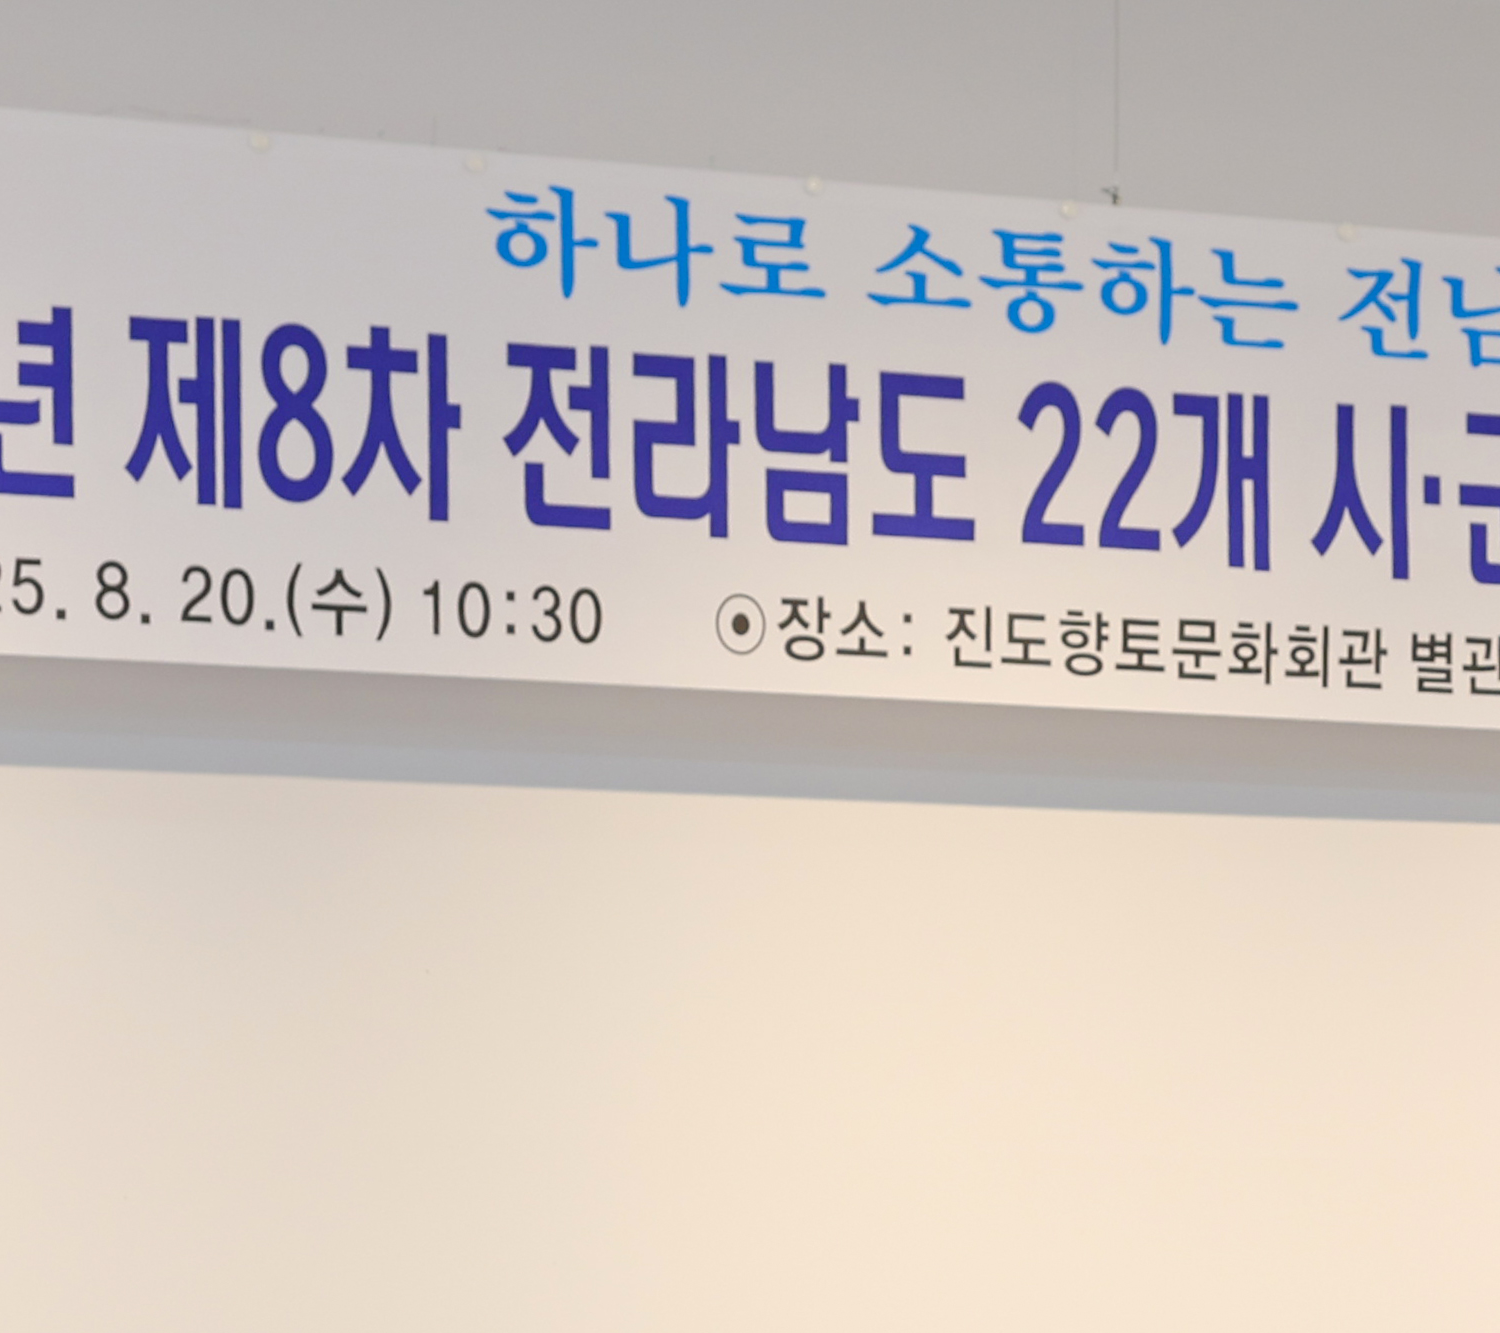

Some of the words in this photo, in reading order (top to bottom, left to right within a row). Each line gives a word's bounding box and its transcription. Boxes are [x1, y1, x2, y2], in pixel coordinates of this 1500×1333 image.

[488, 186, 825, 306] 하나로
[870, 225, 1298, 348] 소통하는
[126, 317, 461, 521] 제8차
[505, 344, 974, 545] 전라남도
[1020, 382, 1269, 570] 22개
[96, 561, 150, 624] 8.
[182, 564, 391, 640] 20.(수)
[423, 581, 610, 644] 10:30
[779, 597, 912, 660] 장소:
[947, 606, 1388, 690] 진도향토문화회관
